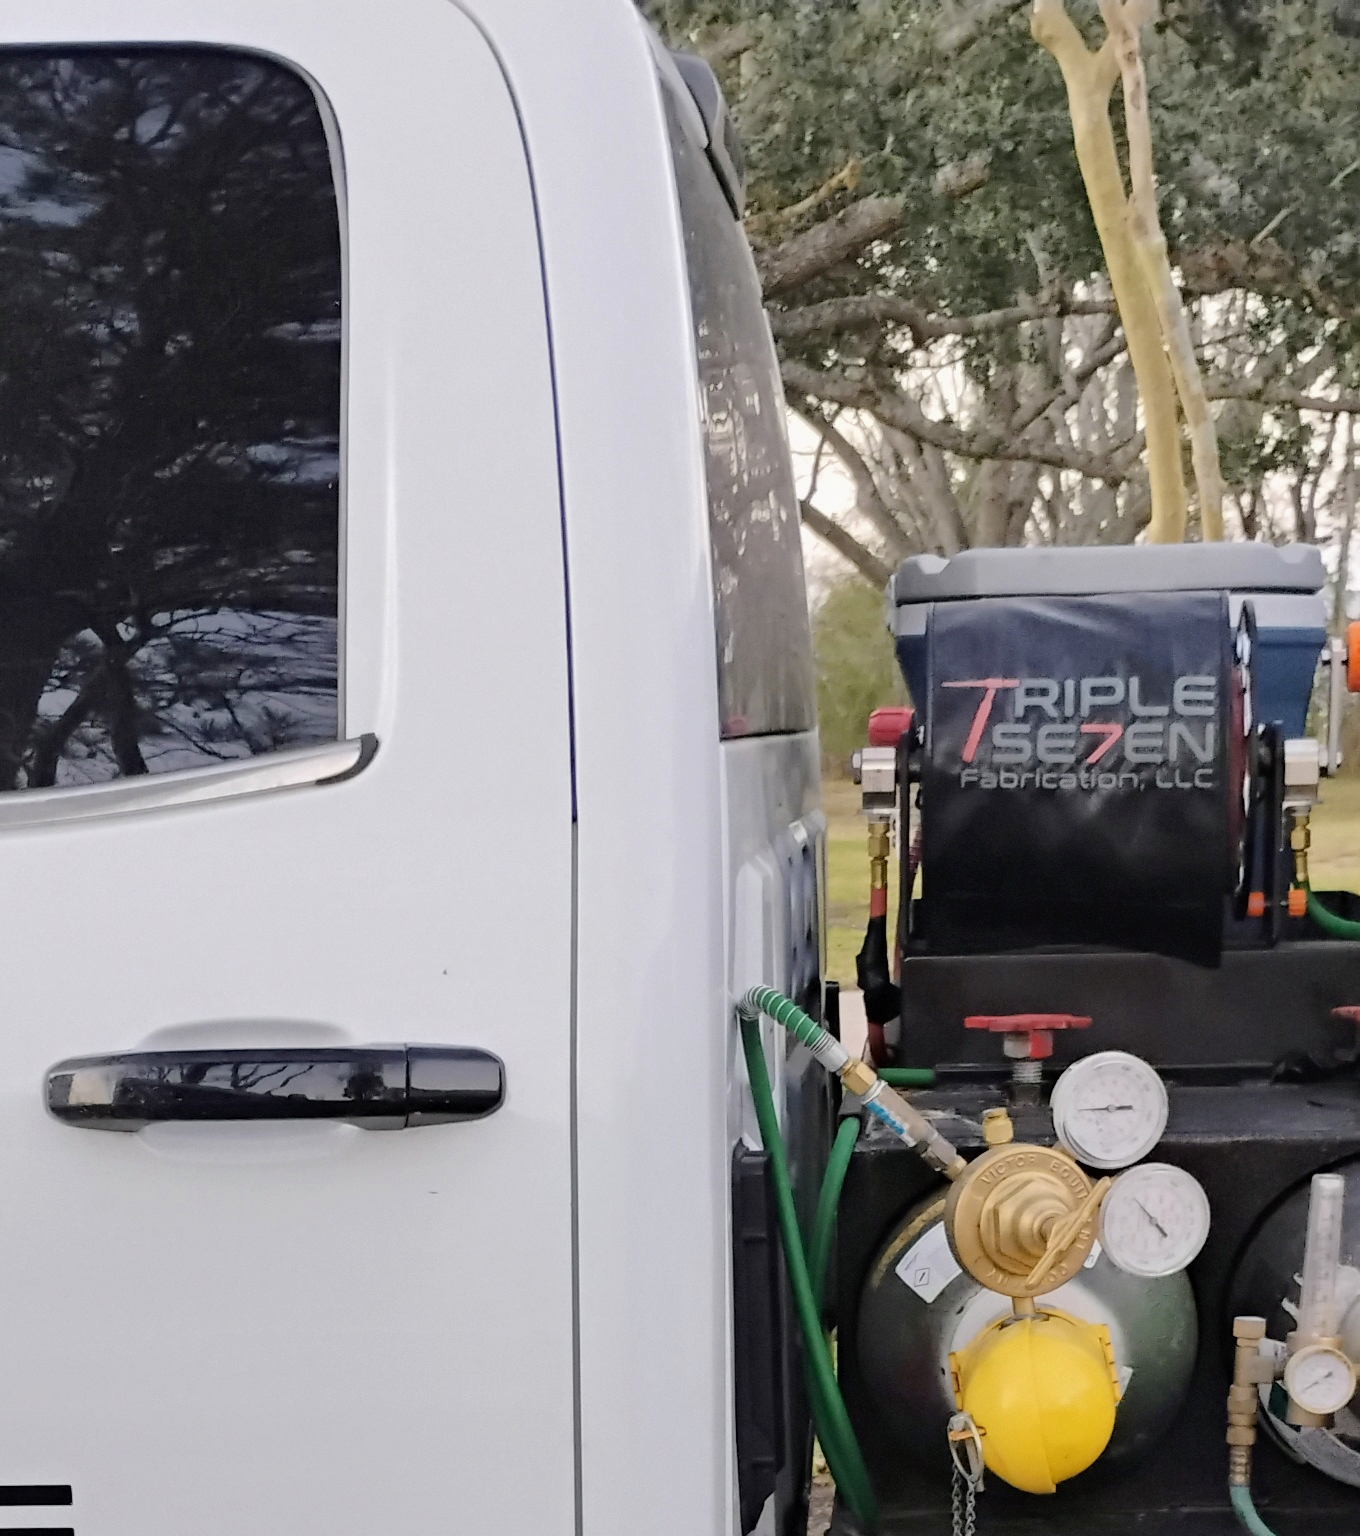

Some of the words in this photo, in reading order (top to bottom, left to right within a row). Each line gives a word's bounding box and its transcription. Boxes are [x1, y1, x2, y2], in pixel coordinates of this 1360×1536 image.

[991, 722, 1216, 764] SE7EN
[959, 768, 1146, 792] Fabrication,
[1155, 768, 1214, 789] LLC
